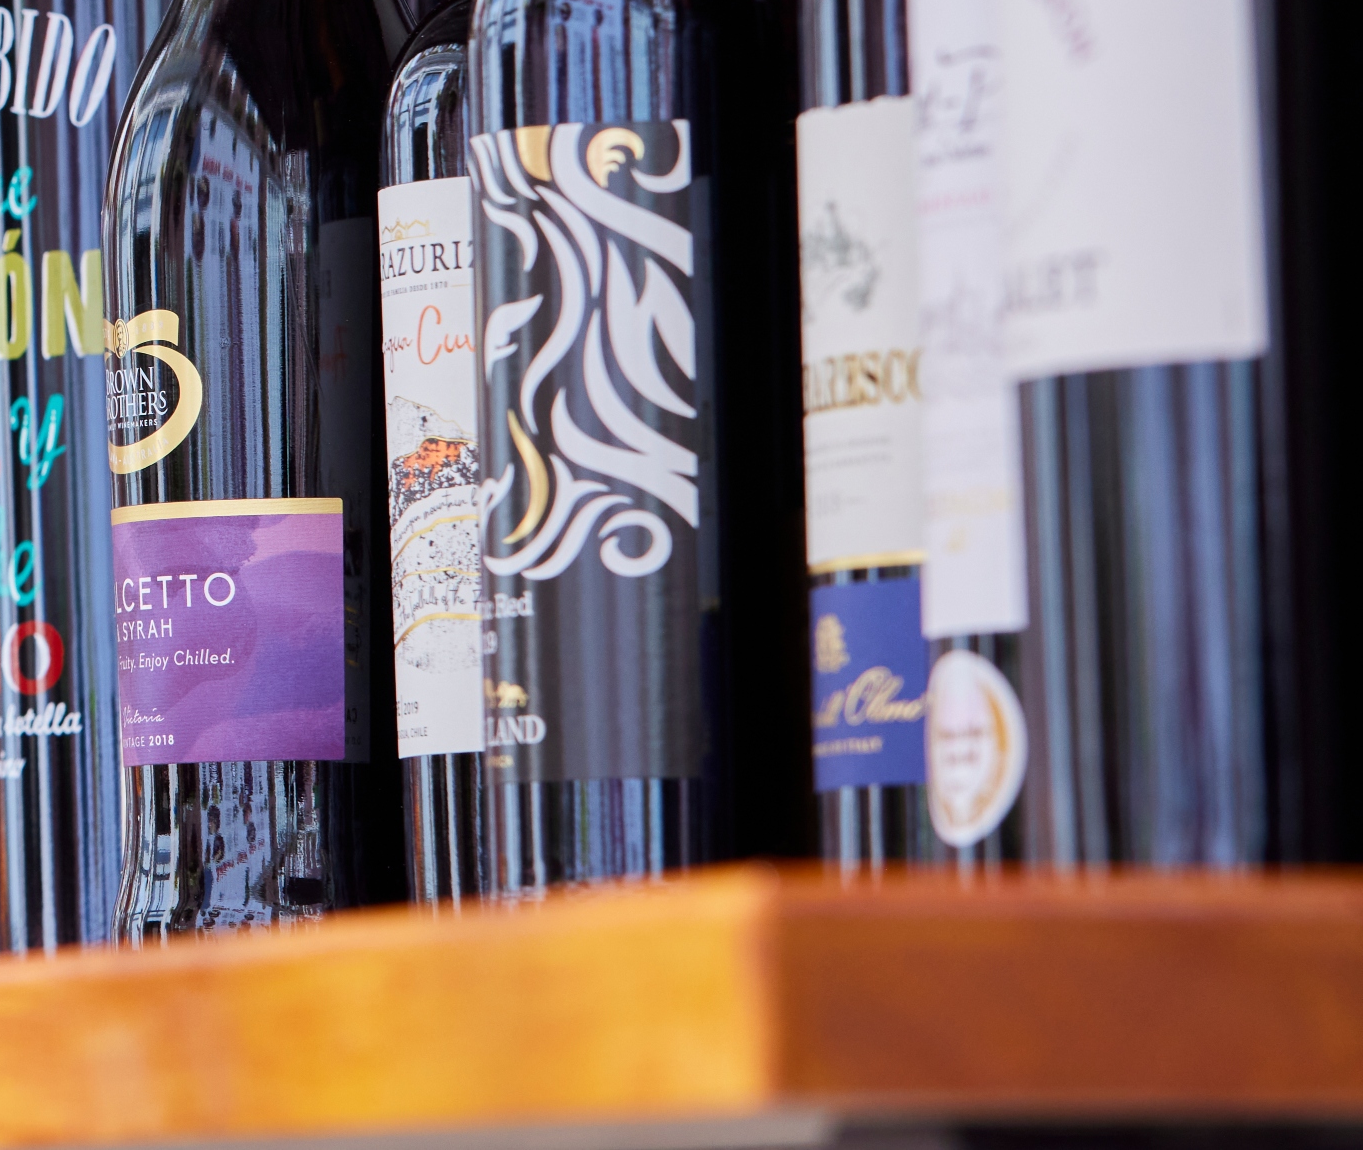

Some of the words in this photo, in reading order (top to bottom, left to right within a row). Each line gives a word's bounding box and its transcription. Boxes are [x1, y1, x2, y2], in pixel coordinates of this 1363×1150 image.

[409, 284, 427, 292] DESDE
[430, 281, 448, 289] 1870
[106, 366, 154, 396] BROWN
[118, 418, 158, 429] WINEMAKERS
[493, 590, 534, 618] Red
[122, 618, 173, 642] SYRAH
[138, 653, 169, 672] Enjoy
[173, 648, 235, 665] Chilled.
[3, 701, 83, 736] botella
[122, 704, 165, 728] Victoria
[403, 701, 419, 716] 2019
[148, 734, 175, 746] 2018
[410, 726, 428, 737] CHILE
